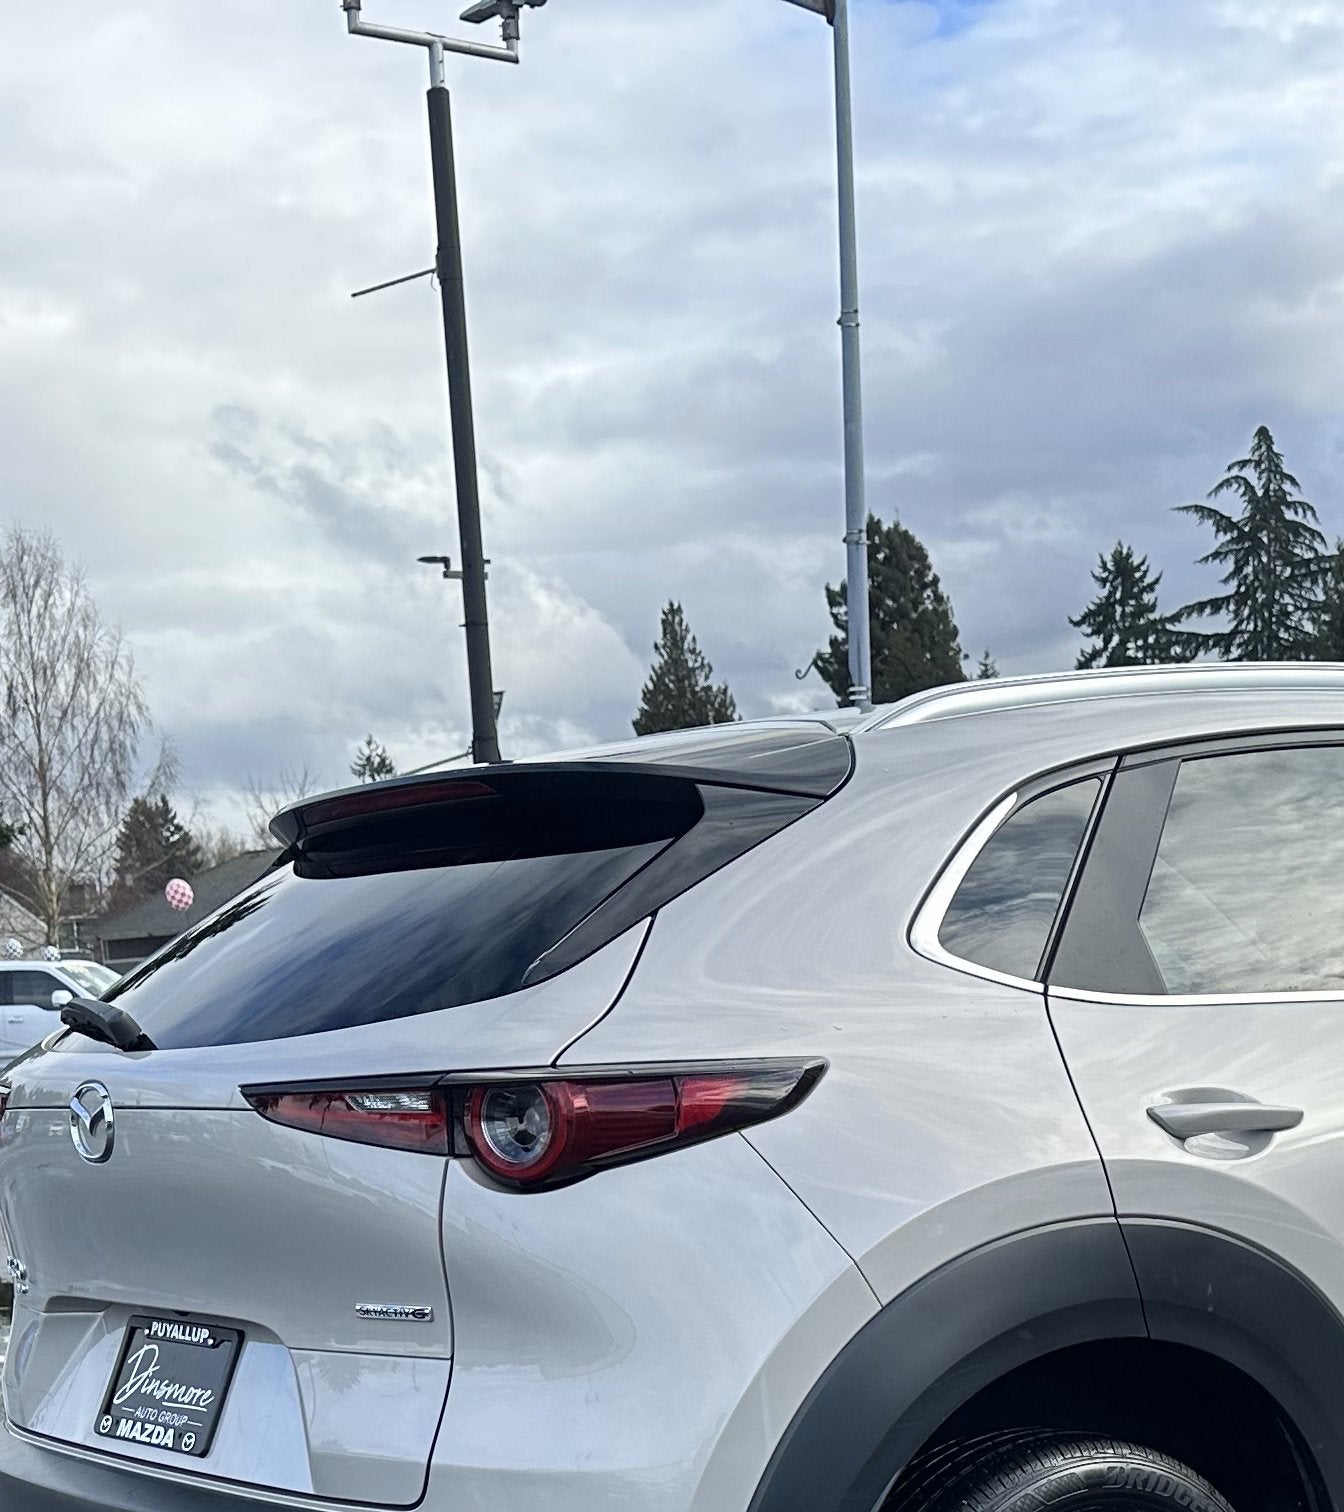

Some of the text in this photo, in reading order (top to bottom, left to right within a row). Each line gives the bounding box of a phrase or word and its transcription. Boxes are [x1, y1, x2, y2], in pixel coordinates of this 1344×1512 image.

[150, 1321, 210, 1344] PUYALLUP
[113, 1344, 215, 1406] Dinsmore
[134, 1406, 189, 1426] AUTO GROUP
[116, 1418, 175, 1447] MAZDA
